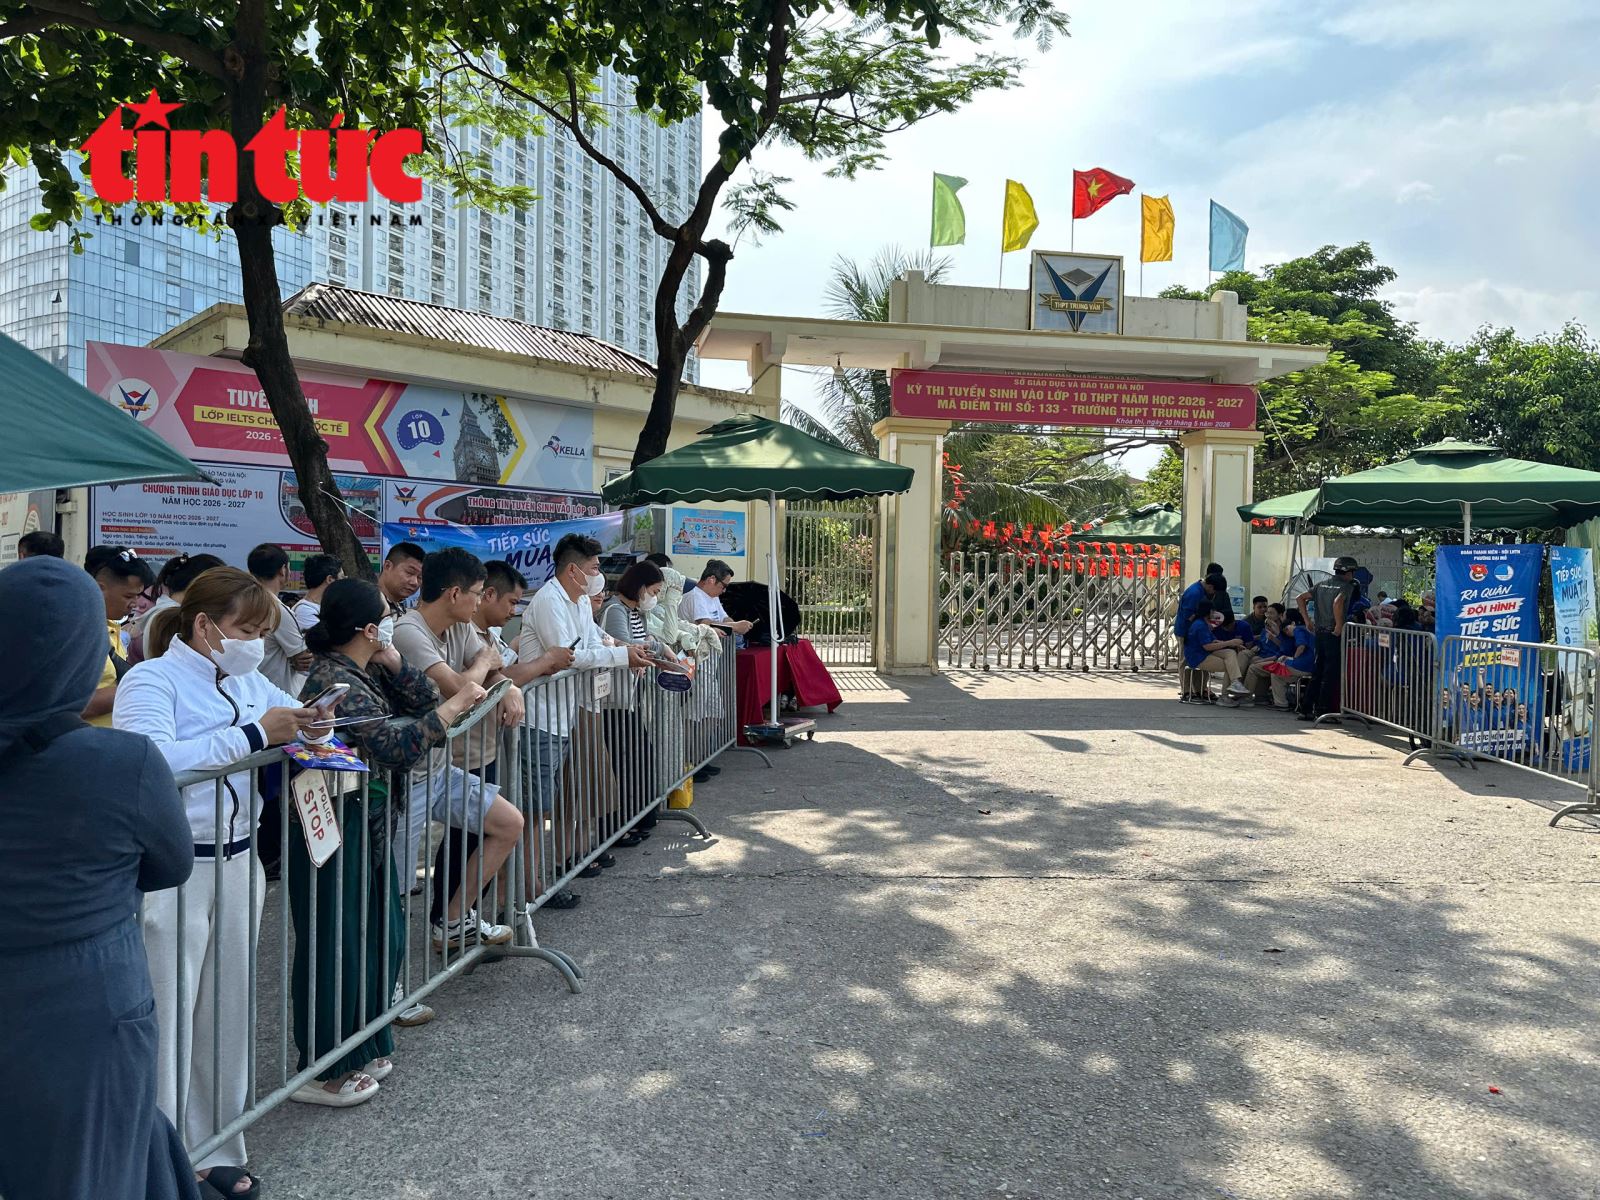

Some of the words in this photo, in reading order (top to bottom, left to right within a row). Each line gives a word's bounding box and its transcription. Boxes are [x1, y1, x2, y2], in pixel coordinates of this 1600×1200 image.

[1055, 301, 1068, 309] THPT
[1088, 302, 1100, 310] VĂN
[1014, 378, 1025, 386] SỞ
[1027, 379, 1047, 387] GIÁO
[1049, 380, 1066, 388] DỤC
[1068, 380, 1078, 388] VÀ
[1080, 381, 1097, 389] ĐÀO
[1117, 382, 1128, 390] HÀ
[906, 384, 922, 395] KỲ
[926, 385, 944, 396] THI
[948, 383, 986, 398] TUYỂN
[989, 388, 1017, 399] SINH
[1021, 386, 1044, 400] VÀO
[1048, 387, 1069, 401] LỚP
[1074, 392, 1087, 402] 10
[1090, 392, 1119, 403] THPT
[1122, 391, 1148, 404] NĂM
[1152, 395, 1174, 407] HỌC
[1178, 396, 1206, 406] 2026
[1217, 398, 1244, 408] 2027
[937, 398, 957, 410] MÃ
[960, 397, 990, 411] ĐIỂM
[993, 401, 1012, 412] THI
[1016, 399, 1035, 413] SỐ:
[1038, 403, 1060, 413] 133
[1072, 403, 1117, 416] TRƯỜNG
[1121, 407, 1149, 417] THPT
[1152, 407, 1188, 418] TRUNG
[1192, 408, 1215, 419] VĂN
[201, 409, 224, 421] LỚP
[227, 413, 255, 424] IELTS
[257, 416, 279, 426] CHU
[330, 422, 343, 433] TẾ
[407, 420, 431, 439] 10
[1173, 419, 1192, 427] tháng
[246, 431, 271, 440] 2026
[142, 484, 174, 494] CHƯƠNG
[177, 485, 200, 496] TRÌNH
[202, 486, 220, 497] GIÁO
[222, 488, 236, 499] DỤC
[238, 487, 252, 499] LỚP
[254, 491, 264, 499] 10
[162, 495, 180, 505] NĂM
[183, 498, 201, 506] HỌC
[203, 499, 221, 507] 2026
[228, 500, 245, 508] 2027
[467, 495, 495, 509] THÔNG
[495, 499, 509, 509] TIN
[511, 497, 536, 511] TUYỂN
[537, 502, 555, 513] SINH
[556, 501, 571, 514] VÀO
[572, 503, 586, 515] LỚP
[587, 506, 597, 516] 10
[487, 531, 519, 553] TIẾP
[522, 527, 551, 547] SỨC
[505, 544, 551, 570] MÙA
[1460, 589, 1478, 601] RA
[1480, 584, 1513, 598] QUÂN
[1467, 605, 1486, 615] ĐỘI
[1489, 601, 1516, 612] HÌNH
[1460, 617, 1489, 636] TIẾP
[1491, 614, 1521, 632] SỨC
[304, 790, 324, 840] STOP
[319, 786, 333, 826] POLICE
